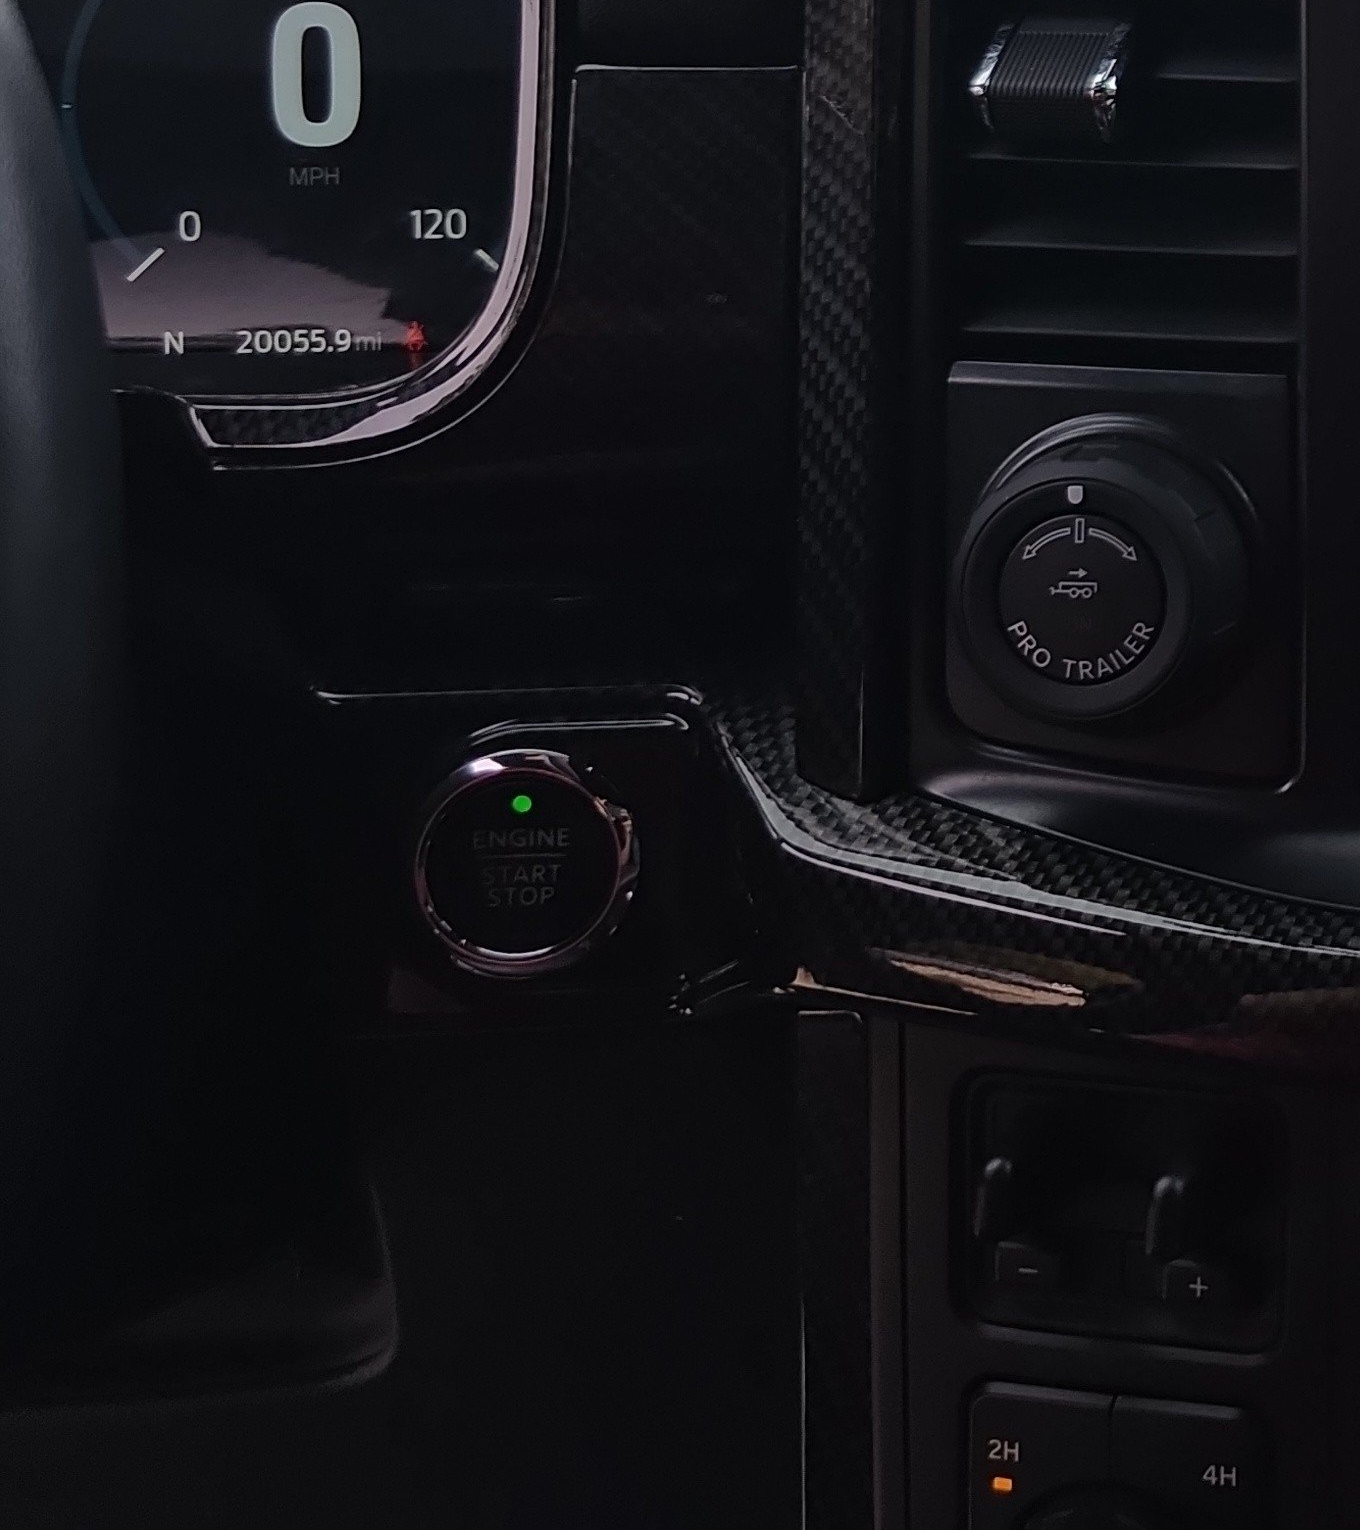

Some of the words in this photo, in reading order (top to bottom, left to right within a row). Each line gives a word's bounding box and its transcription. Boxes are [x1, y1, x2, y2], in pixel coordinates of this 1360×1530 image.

[272, 2, 361, 147] 0
[289, 167, 340, 187] MPH
[179, 211, 200, 241] 0
[410, 209, 467, 239] 120
[164, 331, 184, 354] N
[236, 329, 351, 354] 20055.9
[355, 333, 382, 351] mi
[1007, 621, 1051, 668] PRO
[1063, 622, 1155, 680] TRAILER
[473, 828, 571, 849] ENGINE
[481, 865, 561, 885] START
[488, 886, 555, 907] STOP
[988, 1440, 1019, 1461] 2H
[1202, 1465, 1237, 1487] 4H
